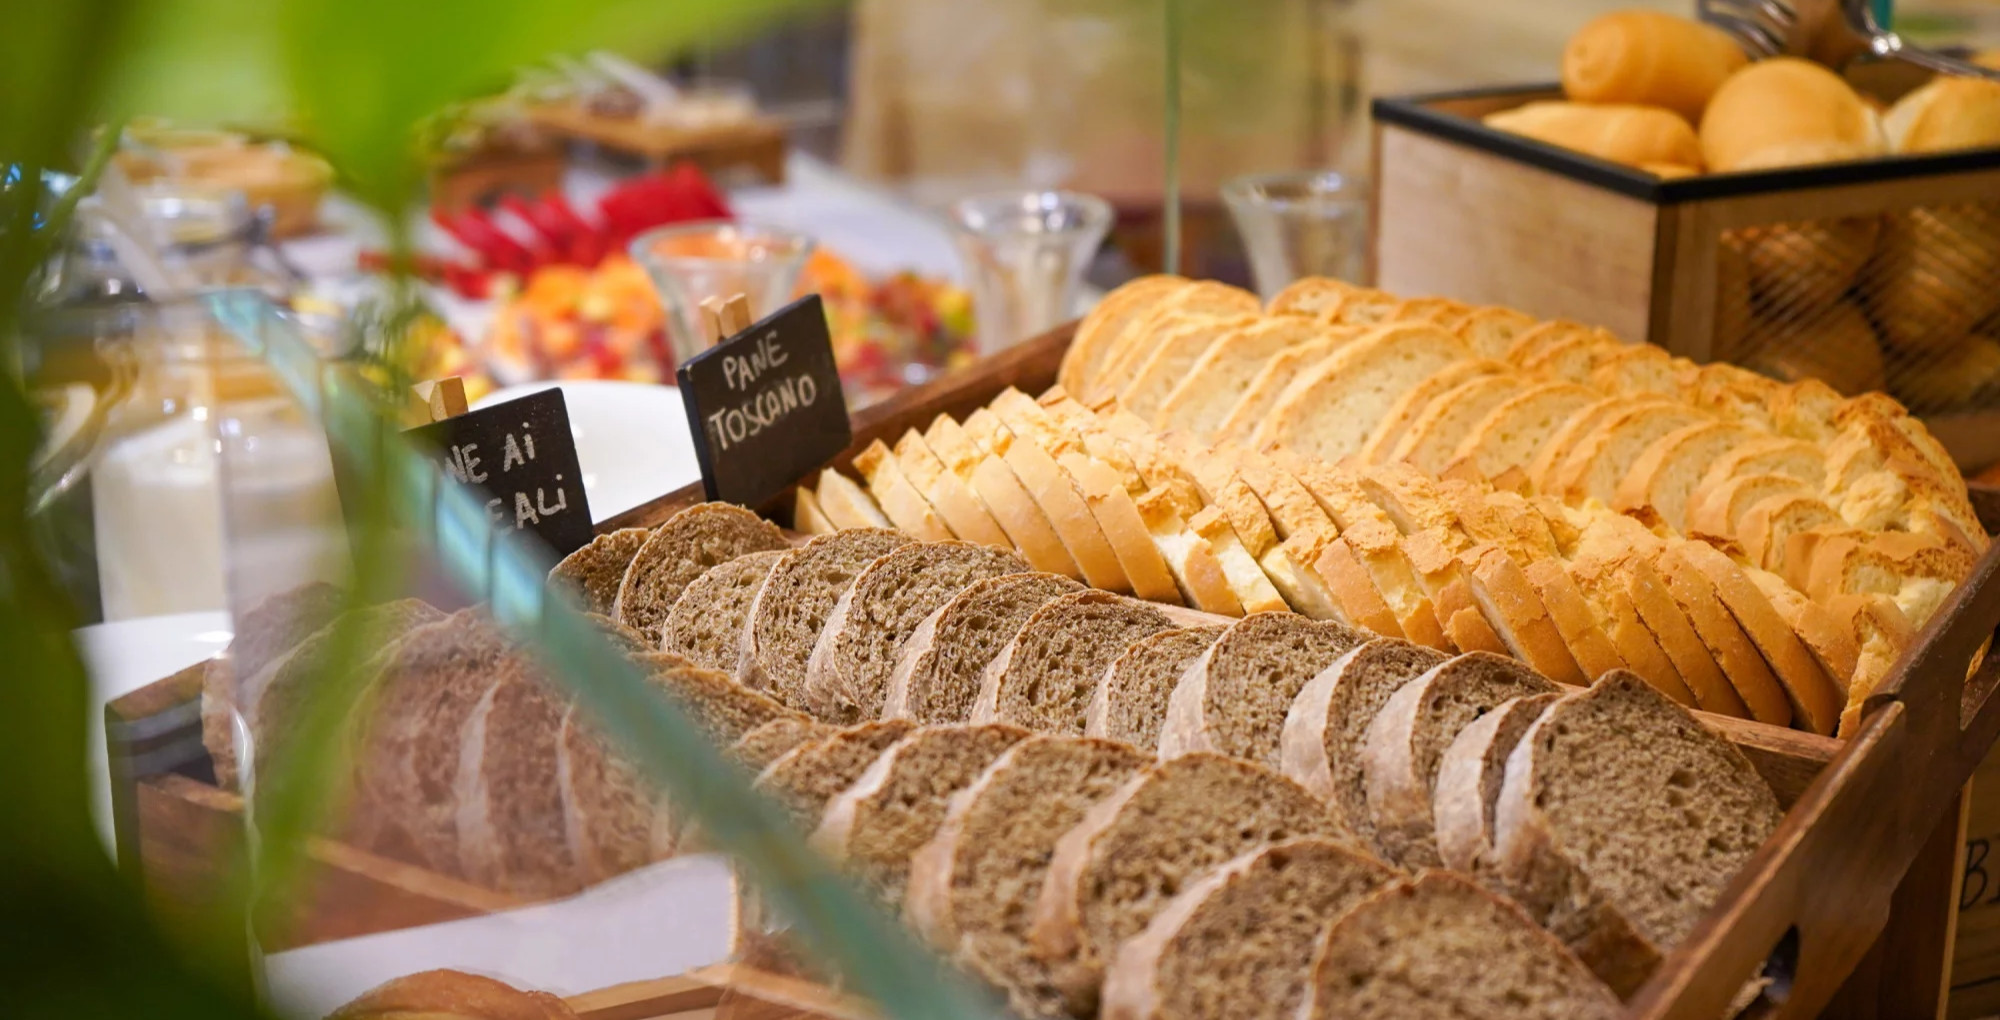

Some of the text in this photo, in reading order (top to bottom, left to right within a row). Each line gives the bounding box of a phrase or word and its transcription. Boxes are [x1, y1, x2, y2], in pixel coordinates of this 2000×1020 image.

[722, 330, 789, 392] PANE
[708, 373, 817, 451] TOSCANO
[442, 442, 489, 485] NE
[484, 473, 567, 535] EALi
